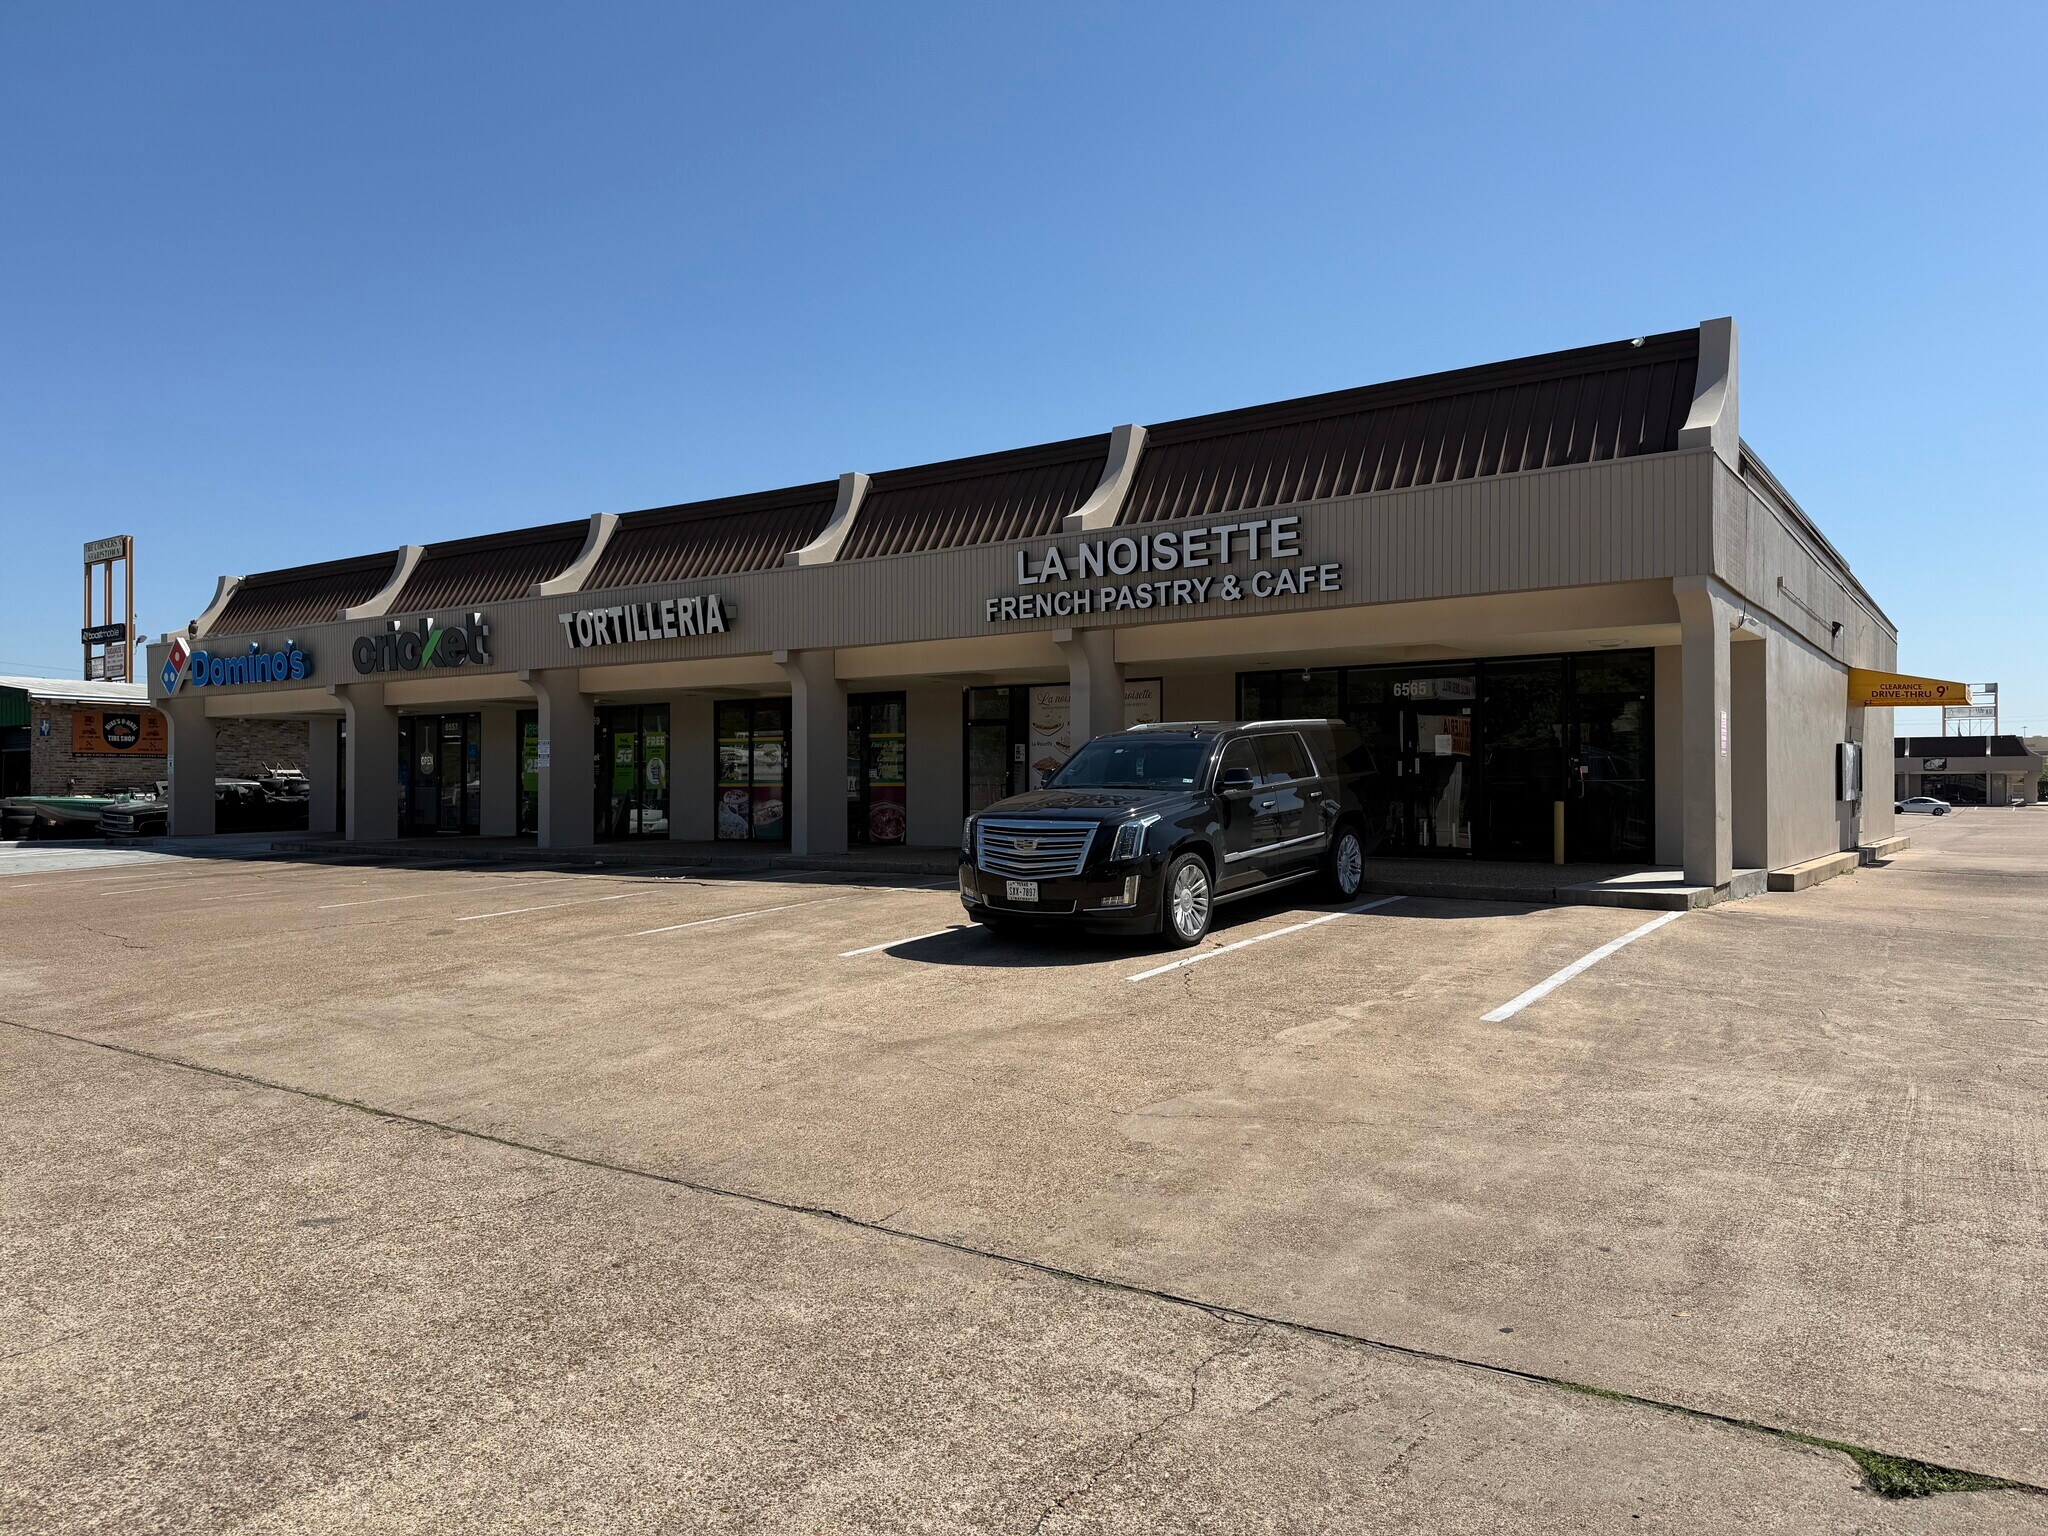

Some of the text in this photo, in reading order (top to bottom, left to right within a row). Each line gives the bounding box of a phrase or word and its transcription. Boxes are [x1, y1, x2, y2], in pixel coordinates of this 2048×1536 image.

[1017, 516, 1302, 586] LA NOISETTE
[986, 563, 1342, 622] FRENCH PASTRY & CAFE
[352, 613, 488, 674] cricket
[559, 594, 728, 649] TORTILLERIA
[191, 640, 307, 687] Domino's
[1393, 682, 1427, 697] 6565
[1871, 690, 1932, 698] DRIVE-THRU
[616, 749, 633, 763] 5G
[646, 735, 665, 746] FREE
